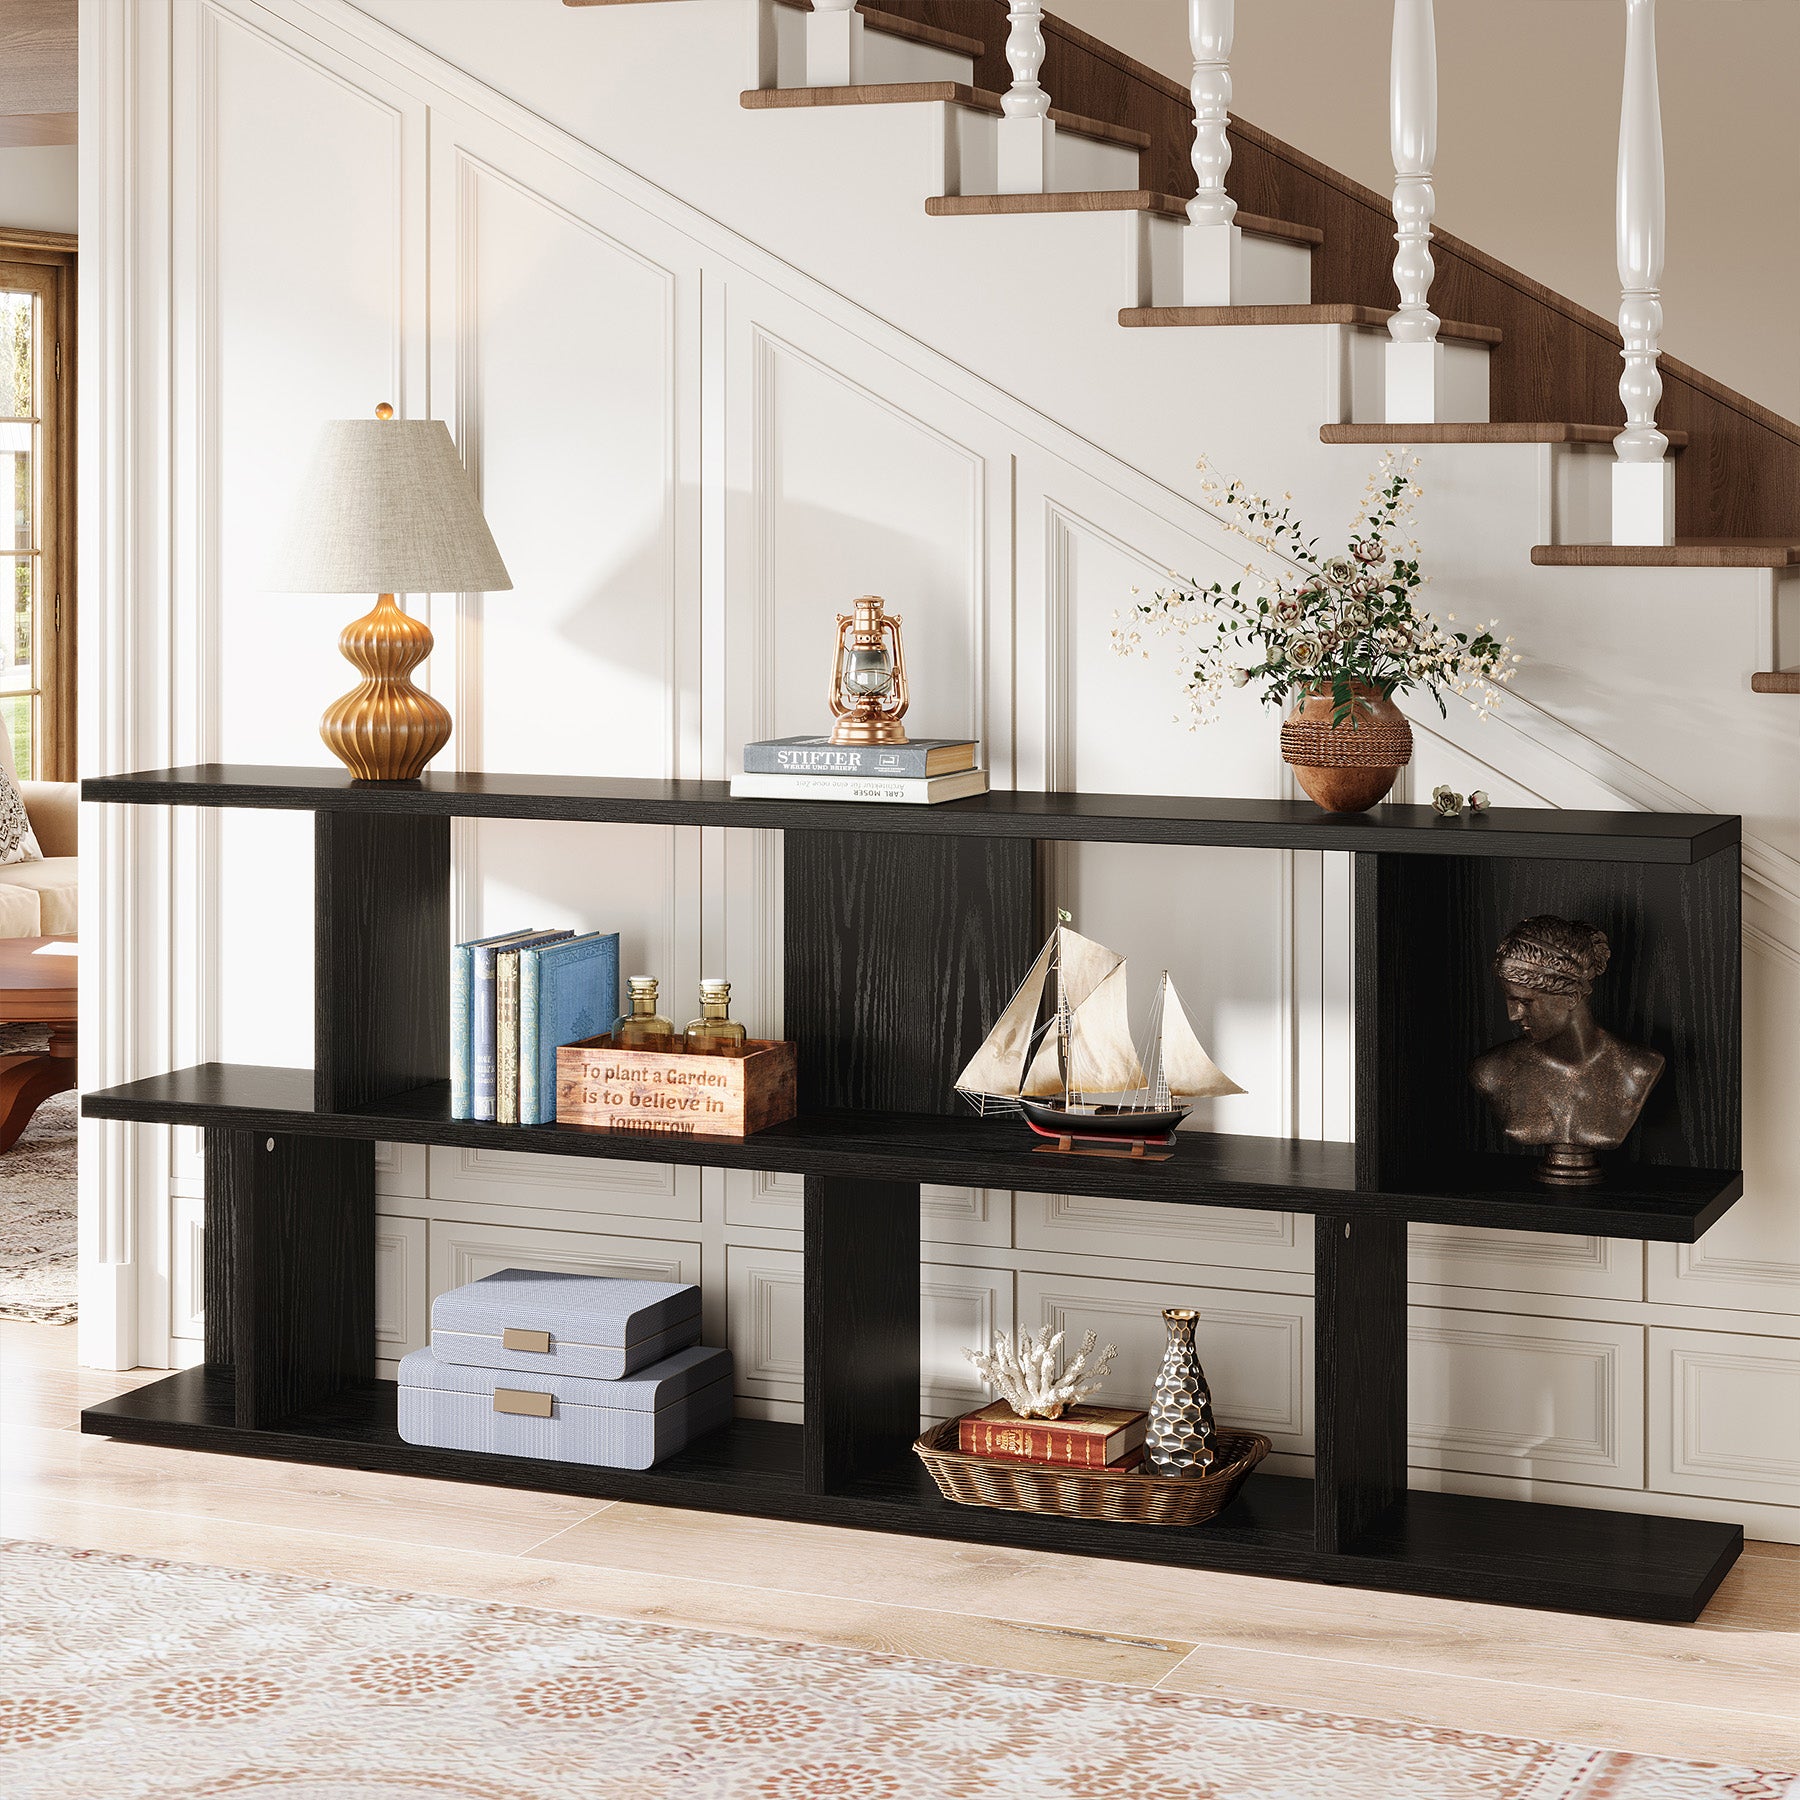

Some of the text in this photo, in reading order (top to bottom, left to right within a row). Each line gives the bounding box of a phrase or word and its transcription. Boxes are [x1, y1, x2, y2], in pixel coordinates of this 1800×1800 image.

[777, 750, 862, 766] STIFTER
[783, 763, 811, 771] WERKE
[853, 789, 905, 798] CARL MOSER
[581, 1063, 727, 1087] To plant a Garden
[582, 1087, 724, 1112] is to believe in
